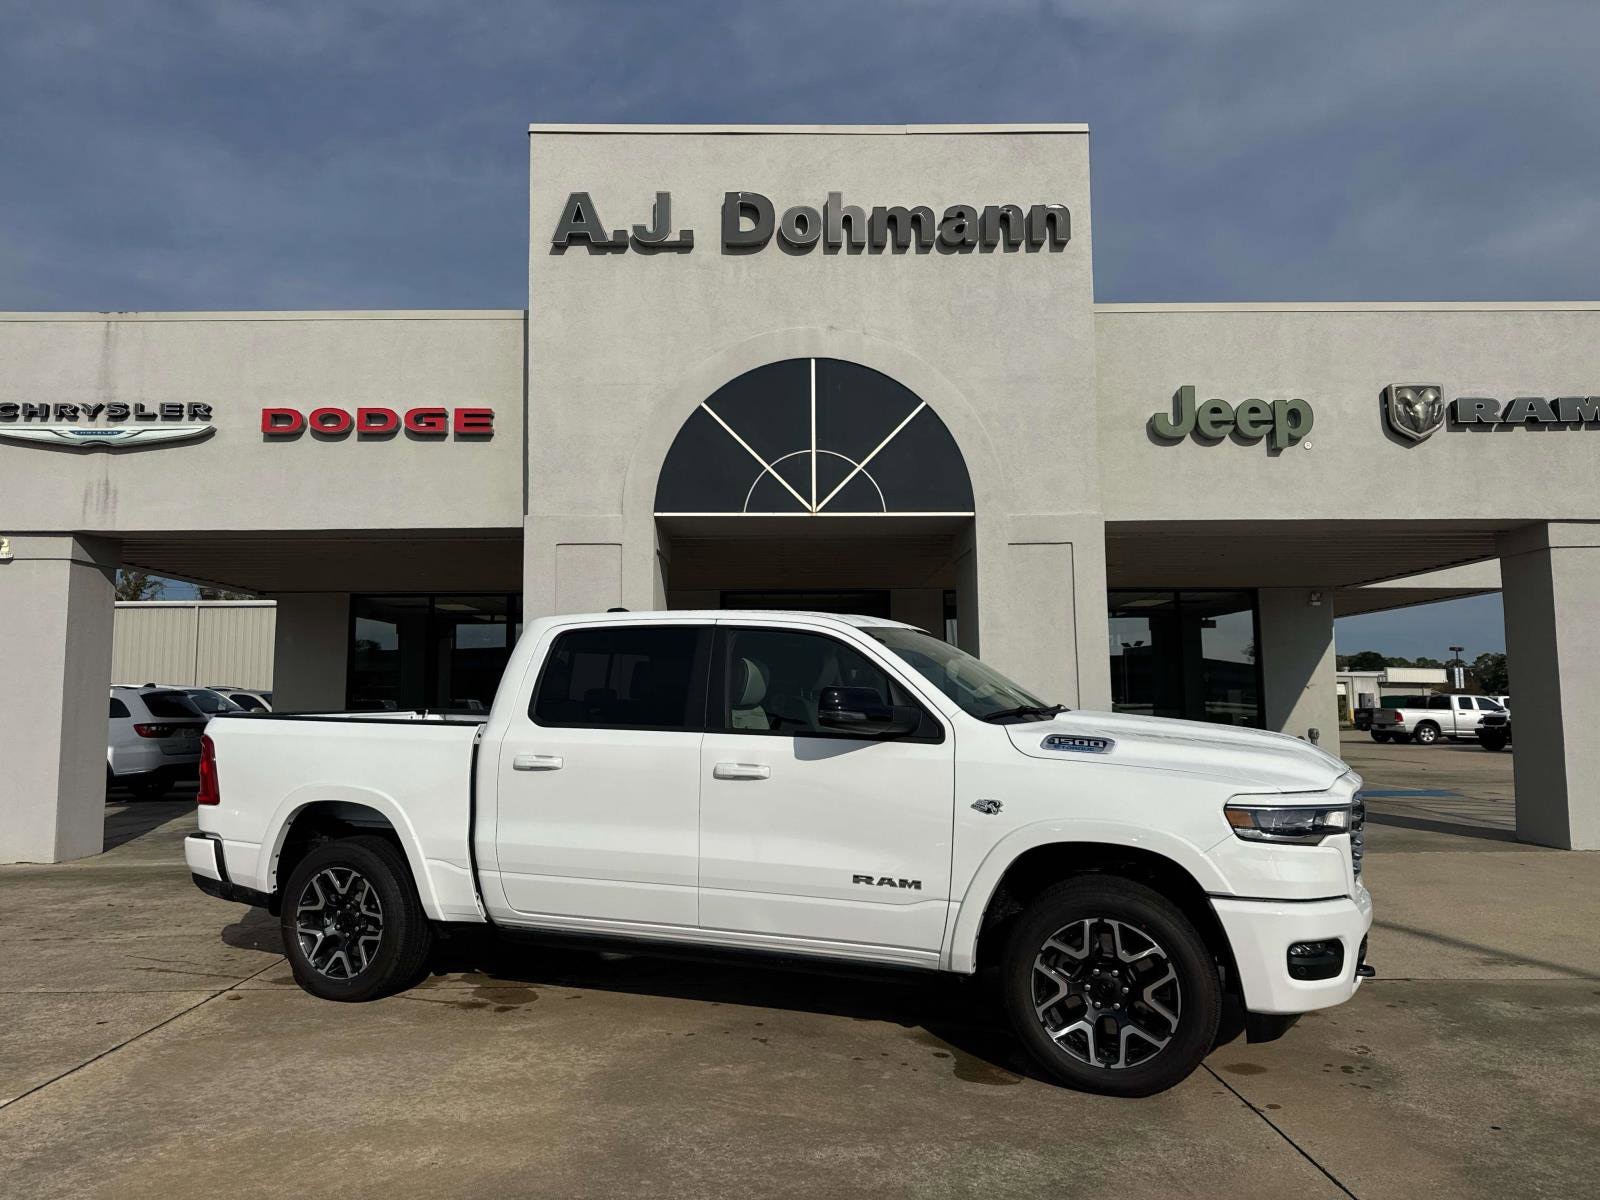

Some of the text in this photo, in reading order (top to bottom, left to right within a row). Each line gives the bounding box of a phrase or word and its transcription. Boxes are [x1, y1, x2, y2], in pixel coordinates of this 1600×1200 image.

[551, 191, 1071, 250] A.J. Dohmann
[0, 402, 213, 421] CHRYSLER
[261, 407, 495, 437] DODGE
[1148, 385, 1314, 450] Jeep
[1449, 397, 1600, 426] RAM
[1052, 737, 1105, 748] 1500
[852, 874, 922, 891] RAM
